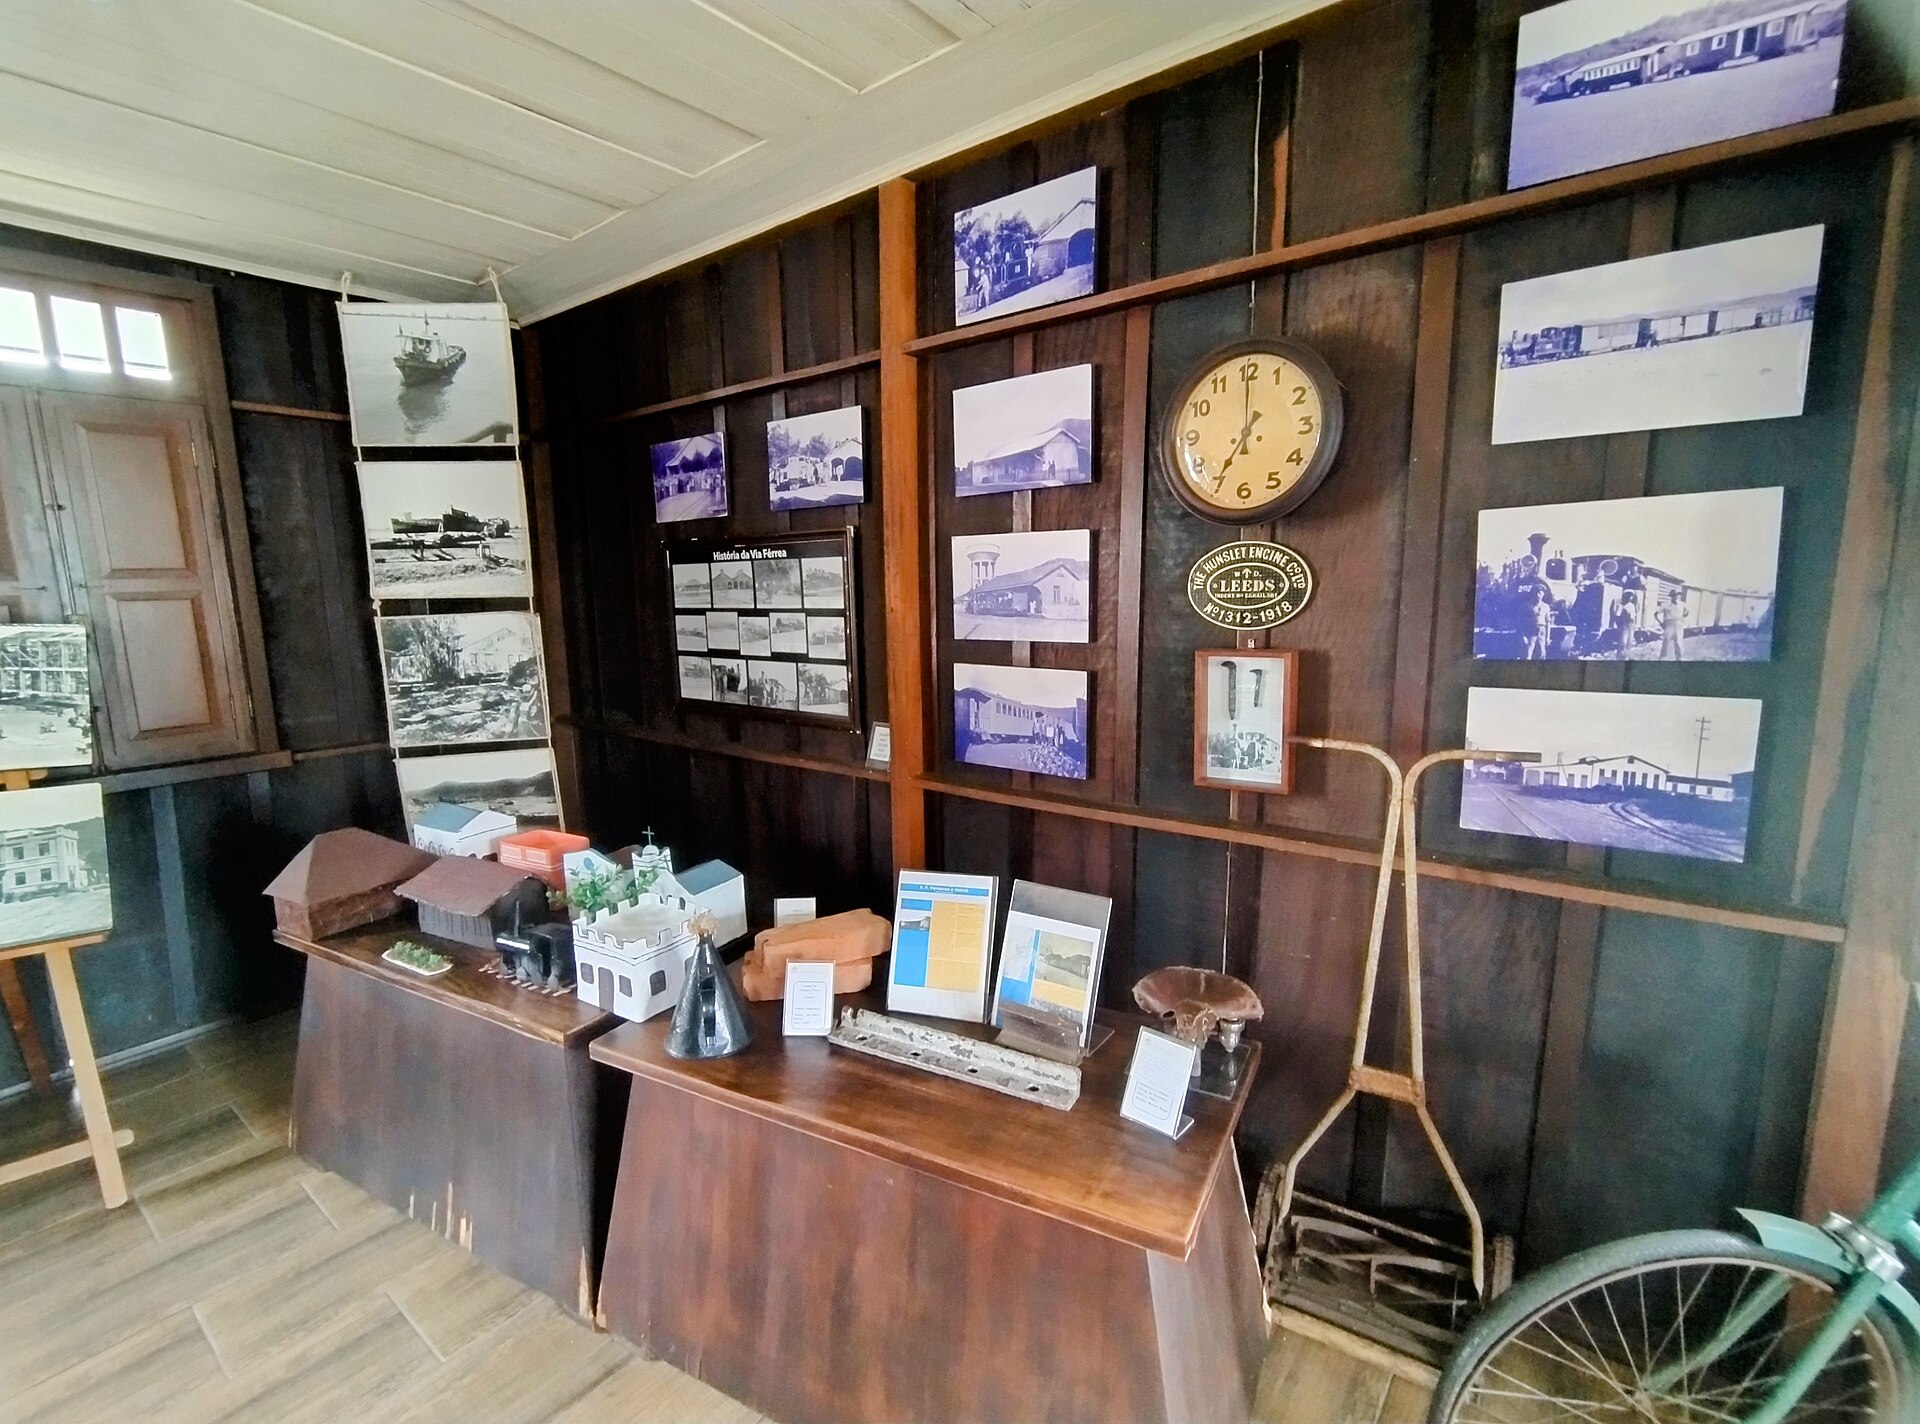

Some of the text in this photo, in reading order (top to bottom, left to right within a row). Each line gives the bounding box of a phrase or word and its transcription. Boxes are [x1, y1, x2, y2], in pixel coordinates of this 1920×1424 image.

[1239, 362, 1259, 382] 12
[1272, 366, 1281, 386] 1
[1211, 375, 1227, 394] 11
[1291, 386, 1307, 406] 2
[1192, 399, 1211, 417] 10
[1297, 415, 1314, 435] 3
[1185, 429, 1200, 446] 9
[1285, 447, 1304, 466] 4
[1212, 475, 1226, 494] 7
[1265, 471, 1281, 490] 5
[1236, 481, 1252, 500] 6
[713, 548, 787, 561] História da Via Férrea
[1193, 571, 1206, 591] THE
[1203, 547, 1247, 573] HUNSLET
[1249, 546, 1290, 567] ENGINE
[1219, 579, 1276, 592] LEEDS
